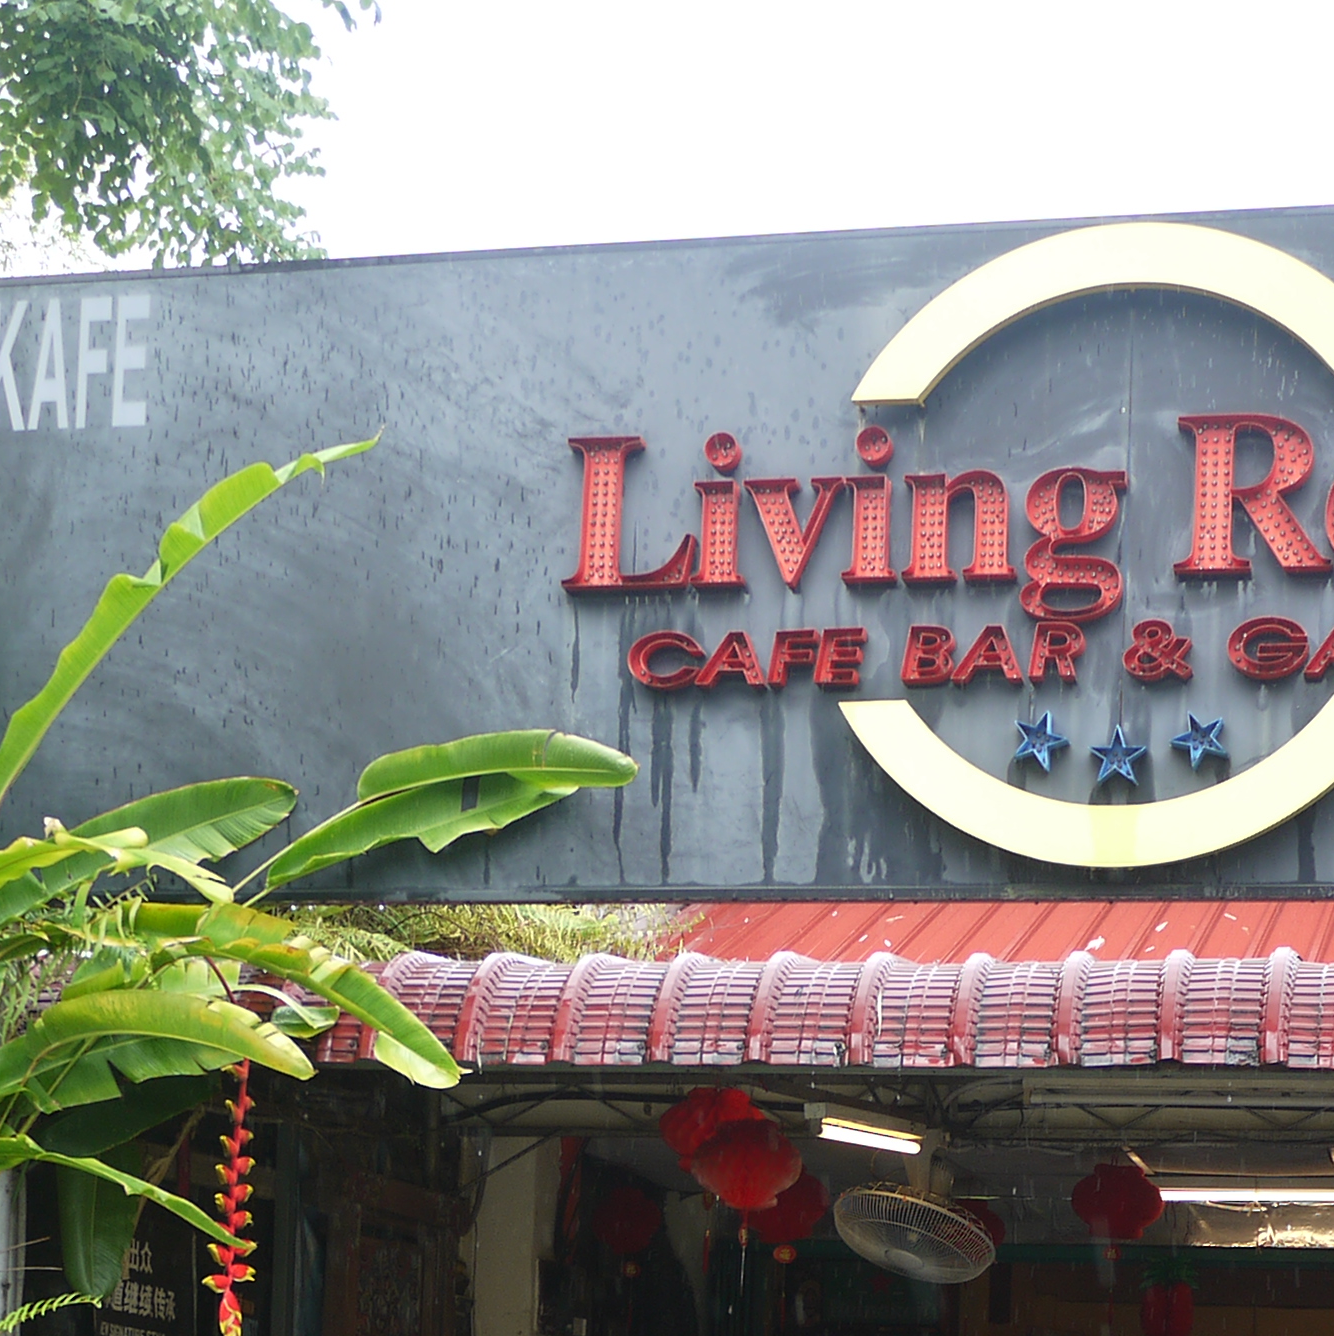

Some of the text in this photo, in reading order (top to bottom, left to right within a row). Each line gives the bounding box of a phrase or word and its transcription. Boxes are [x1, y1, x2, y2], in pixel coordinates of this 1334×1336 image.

[561, 425, 1129, 623] Living
[627, 627, 868, 690] CAFE
[901, 621, 1087, 688] BAR
[1123, 618, 1194, 684] &
